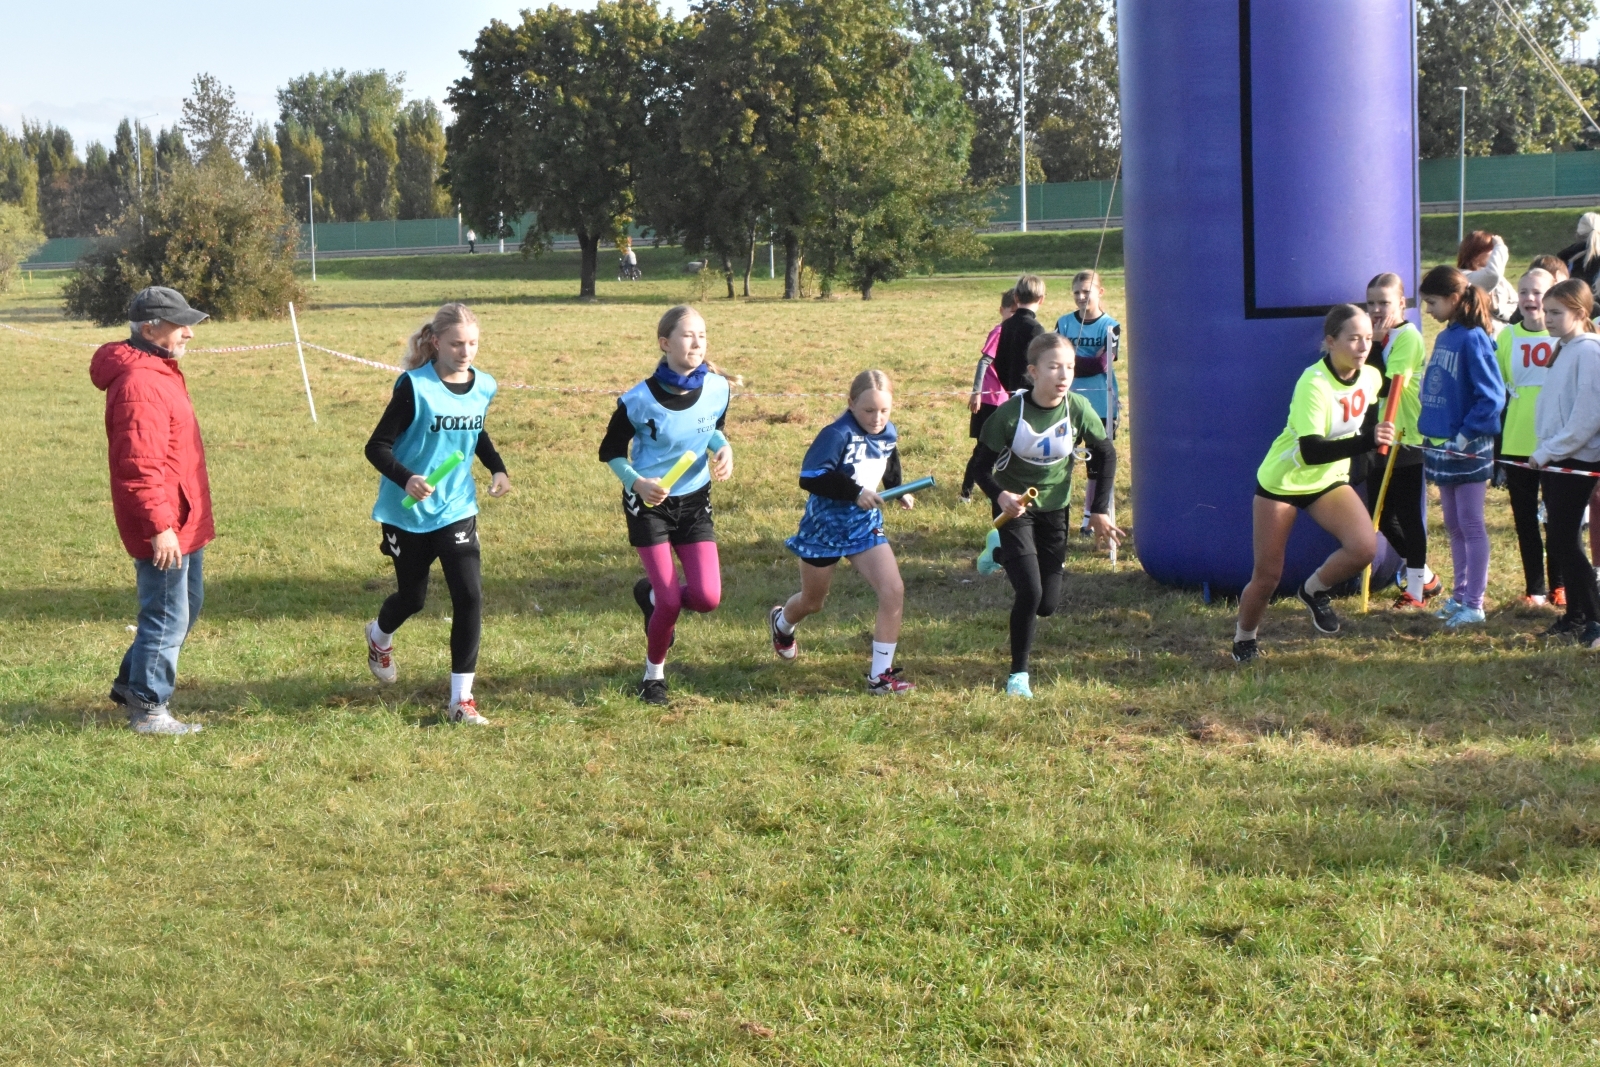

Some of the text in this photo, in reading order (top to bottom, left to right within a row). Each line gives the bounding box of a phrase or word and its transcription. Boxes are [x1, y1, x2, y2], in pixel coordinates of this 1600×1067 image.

[1068, 336, 1102, 347] oma
[1520, 342, 1552, 368] 10
[1339, 388, 1365, 423] 10
[430, 415, 483, 432] Joma
[645, 418, 658, 442] 1
[697, 416, 706, 425] SP
[843, 443, 867, 465] 24
[1037, 436, 1050, 457] 1
